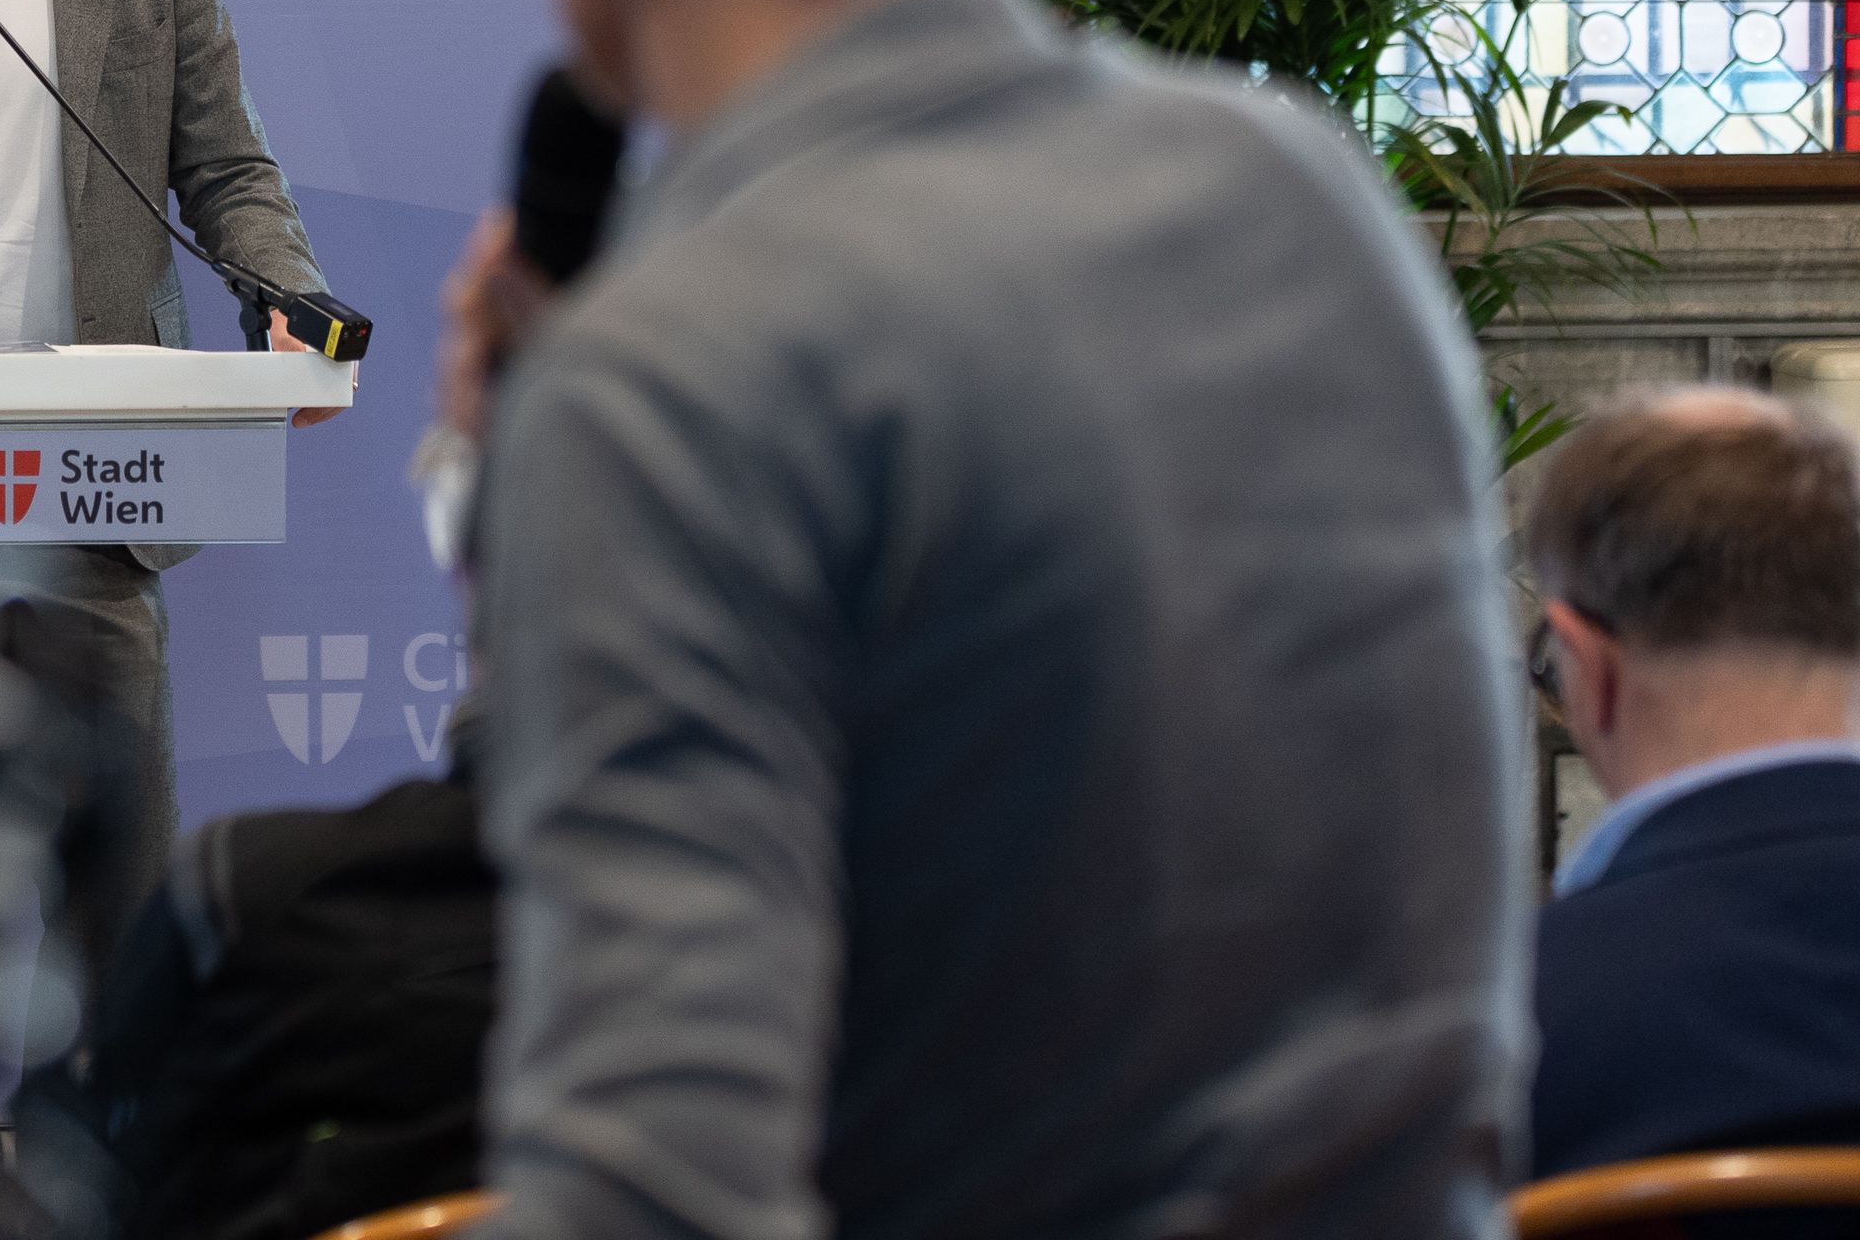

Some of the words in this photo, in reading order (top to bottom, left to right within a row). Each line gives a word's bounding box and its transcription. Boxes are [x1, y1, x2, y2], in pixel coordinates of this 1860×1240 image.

[60, 449, 165, 484] Stadt
[60, 491, 163, 524] Wien
[403, 632, 468, 692] Ci
